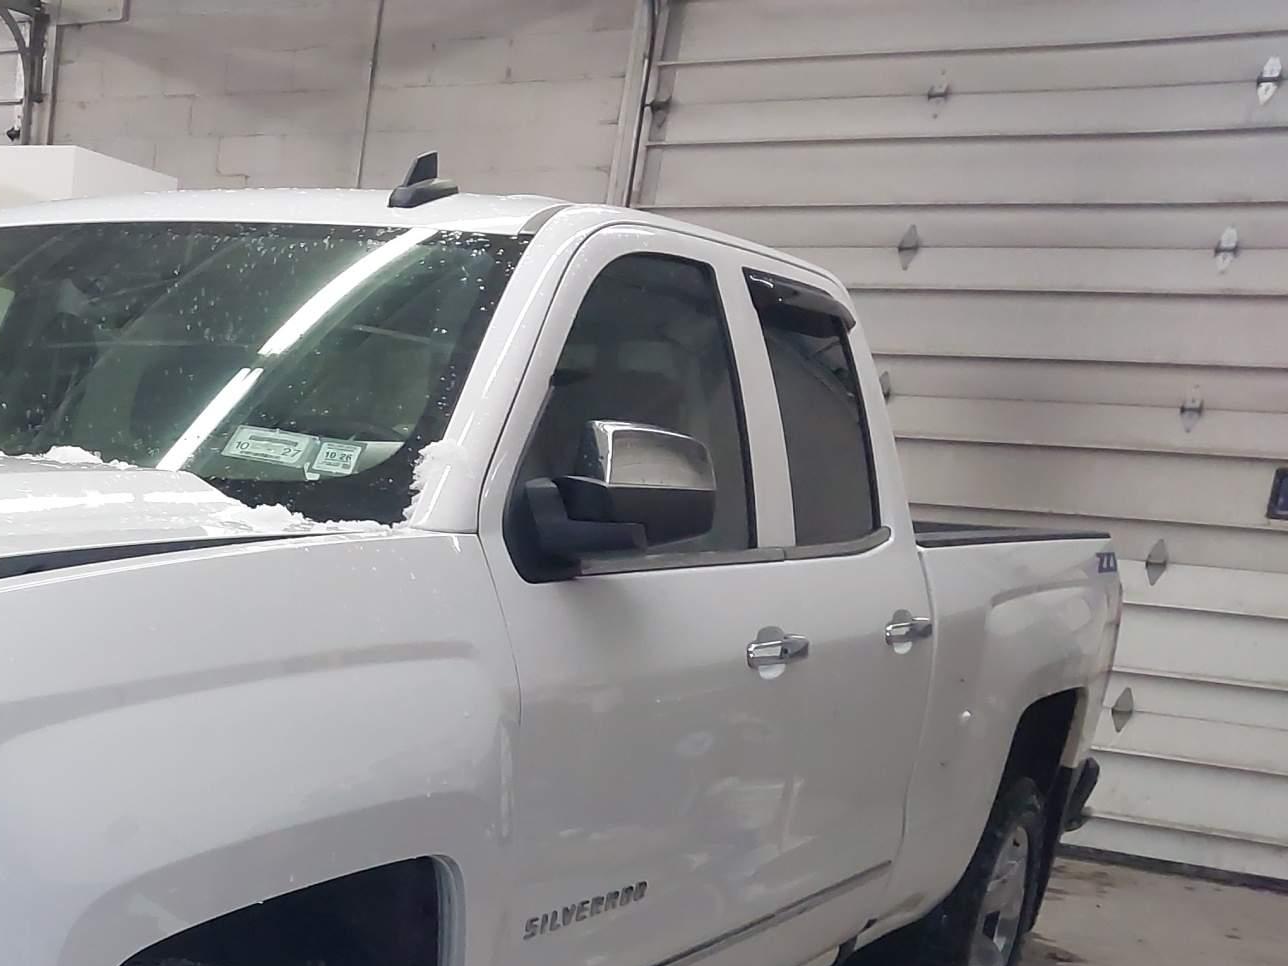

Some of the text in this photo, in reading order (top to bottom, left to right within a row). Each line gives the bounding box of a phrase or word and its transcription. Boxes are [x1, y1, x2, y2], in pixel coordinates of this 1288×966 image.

[235, 441, 250, 450] 10
[280, 447, 302, 458] 27
[325, 451, 337, 459] 10
[523, 880, 648, 940] SILVERADO
